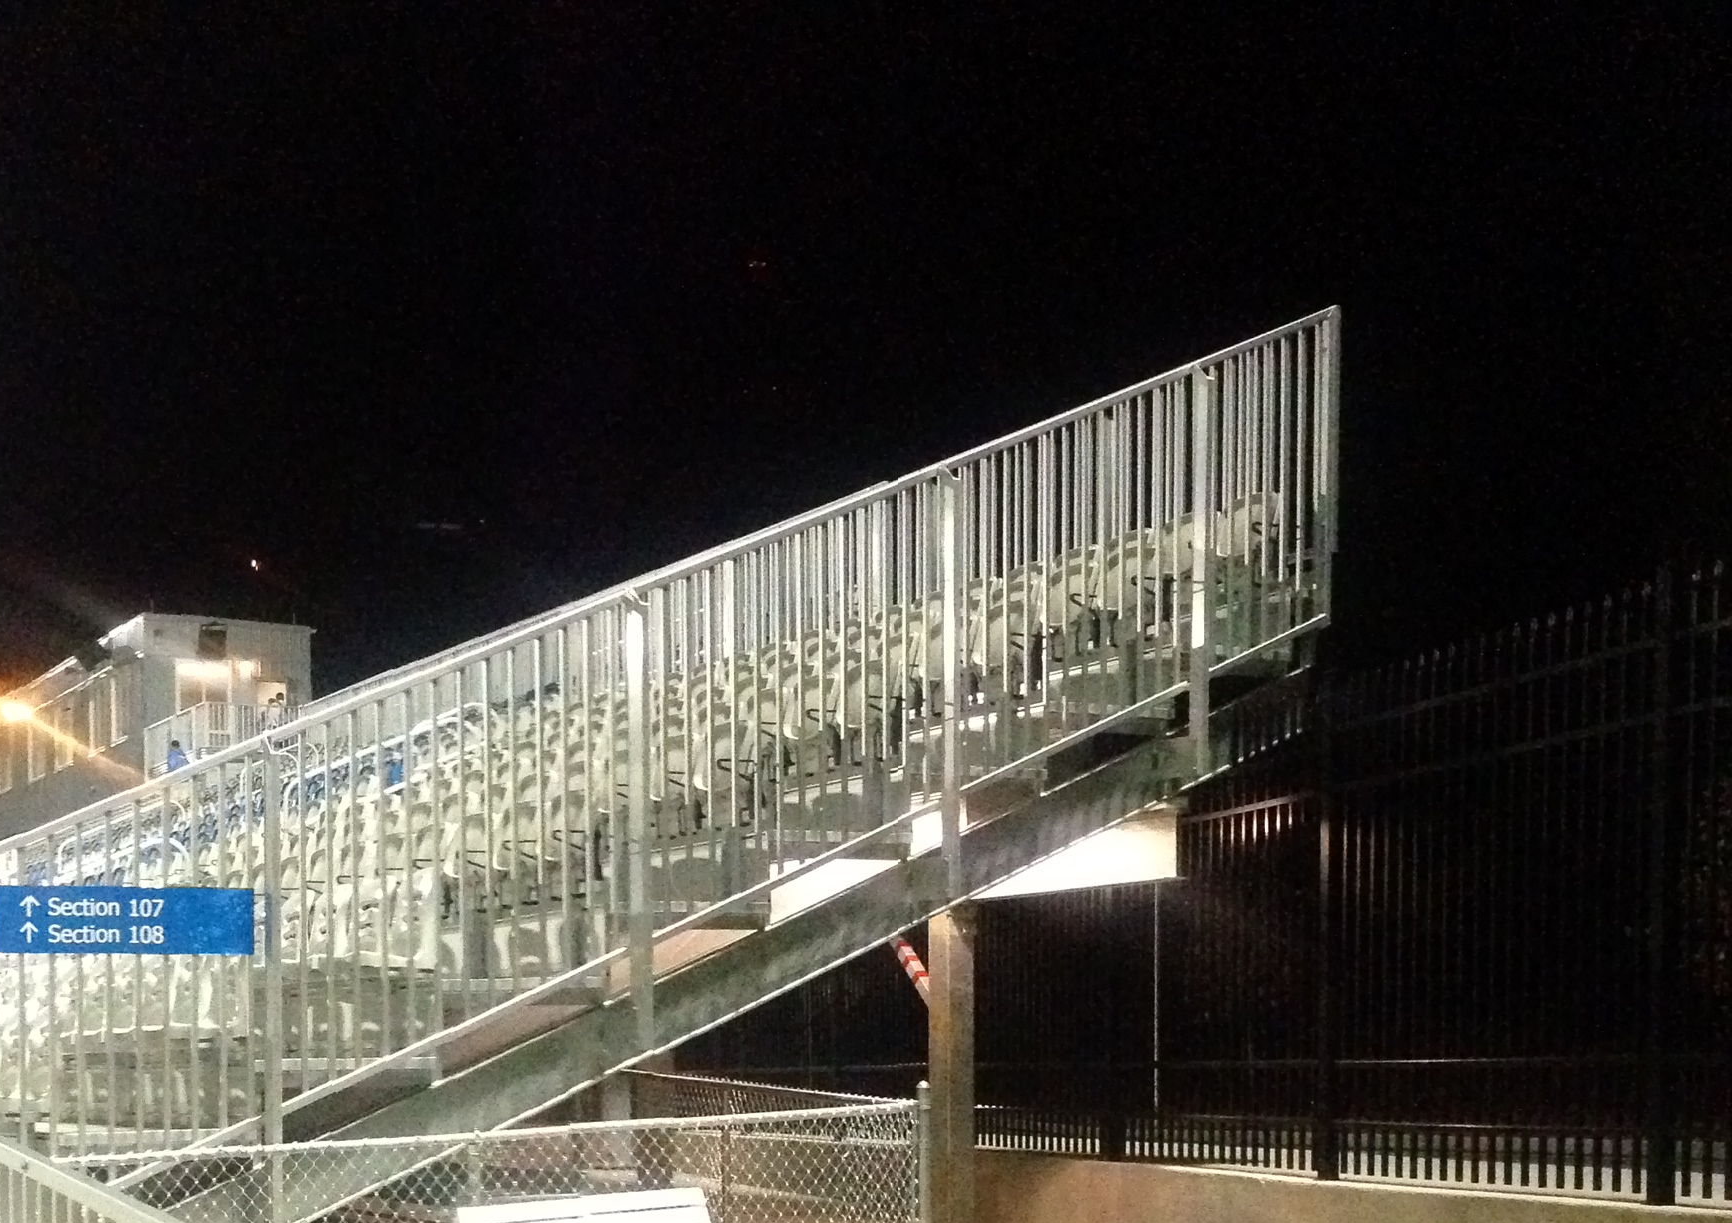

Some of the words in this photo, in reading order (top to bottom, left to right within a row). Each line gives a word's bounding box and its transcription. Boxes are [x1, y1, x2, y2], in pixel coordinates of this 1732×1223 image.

[47, 897, 120, 917] Section
[129, 899, 165, 918] 107
[47, 924, 120, 944] Section
[128, 925, 165, 944] 108
